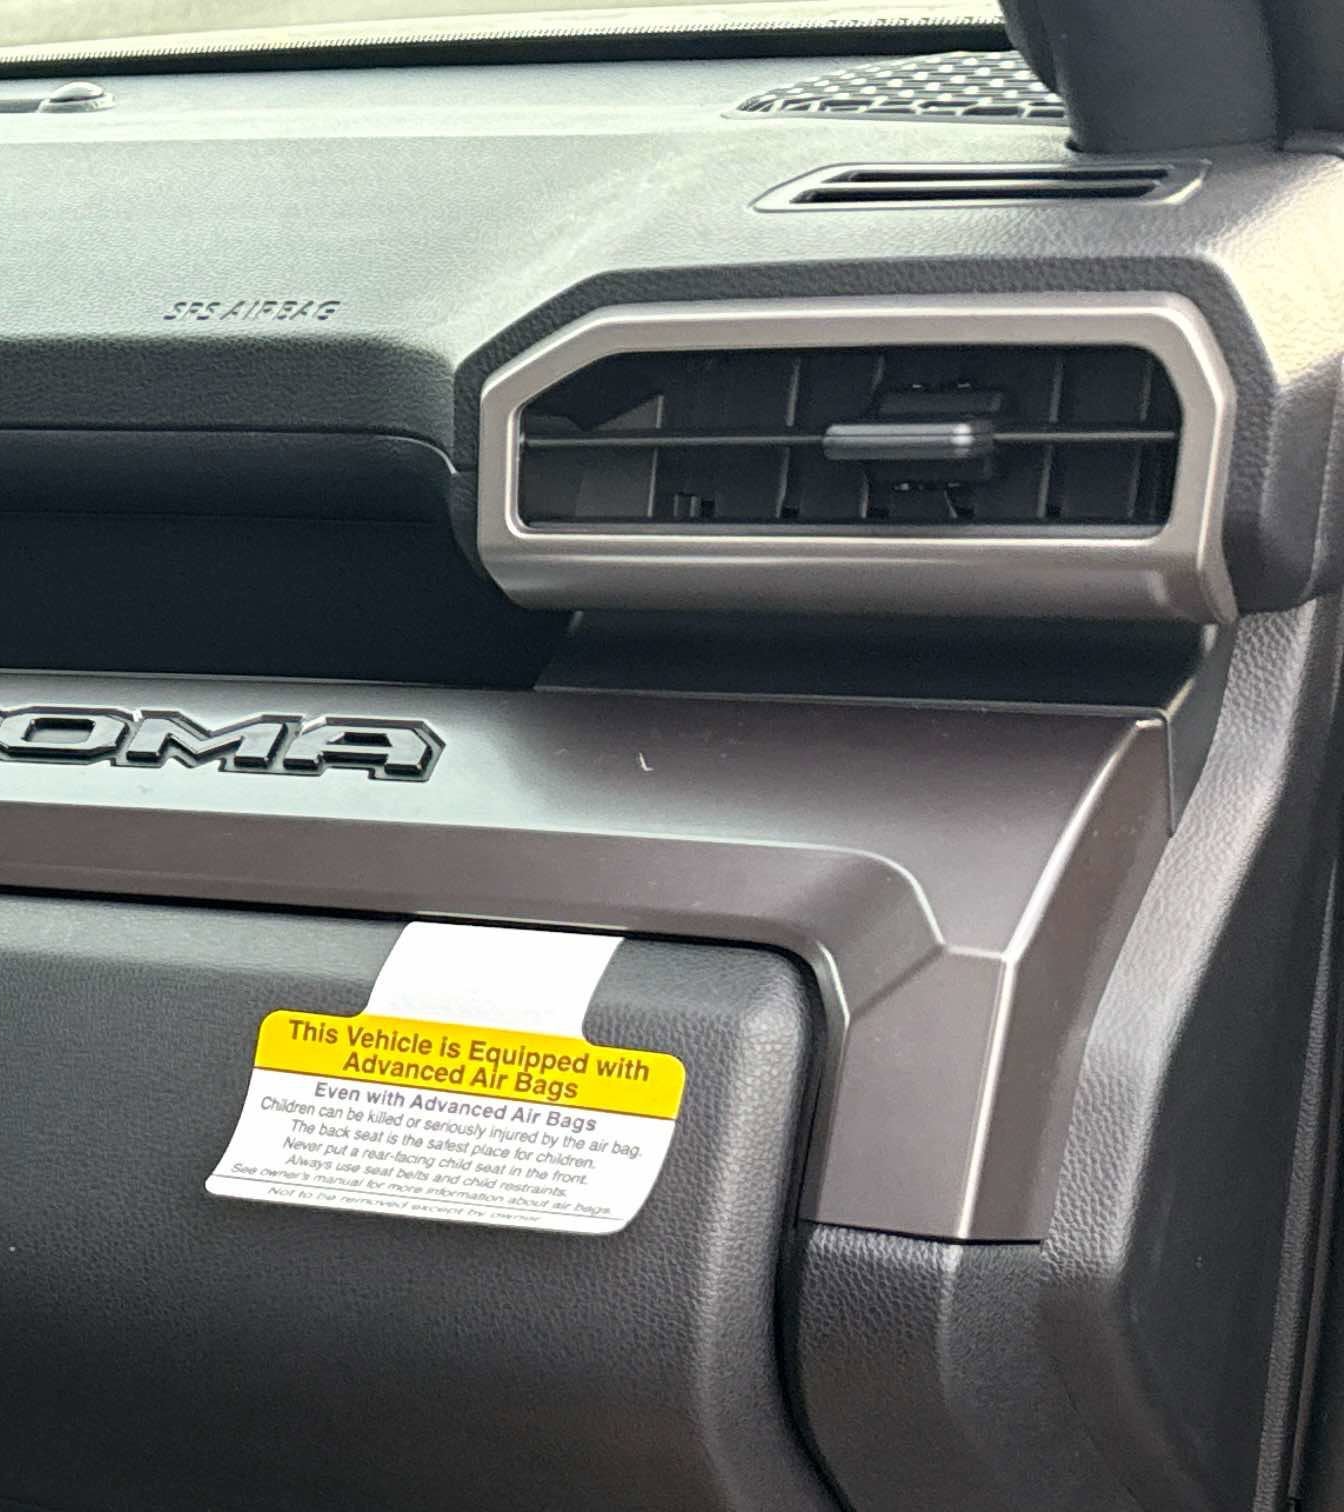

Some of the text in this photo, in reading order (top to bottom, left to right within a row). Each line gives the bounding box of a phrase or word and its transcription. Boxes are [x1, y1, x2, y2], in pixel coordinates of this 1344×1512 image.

[220, 300, 341, 320] AIRBAG
[288, 1019, 650, 1082] This Vehicle is Equipped with
[342, 1052, 579, 1101] Advanced Air Bags
[261, 1096, 642, 1160] Children can be killed or seriously injured by the air bag.
[314, 1082, 597, 1133] Even with Advanced Air Bags
[282, 1136, 588, 1185] Never put a rear-facing child seat in the front.
[291, 1119, 597, 1169] The back seat is the safest place for children.
